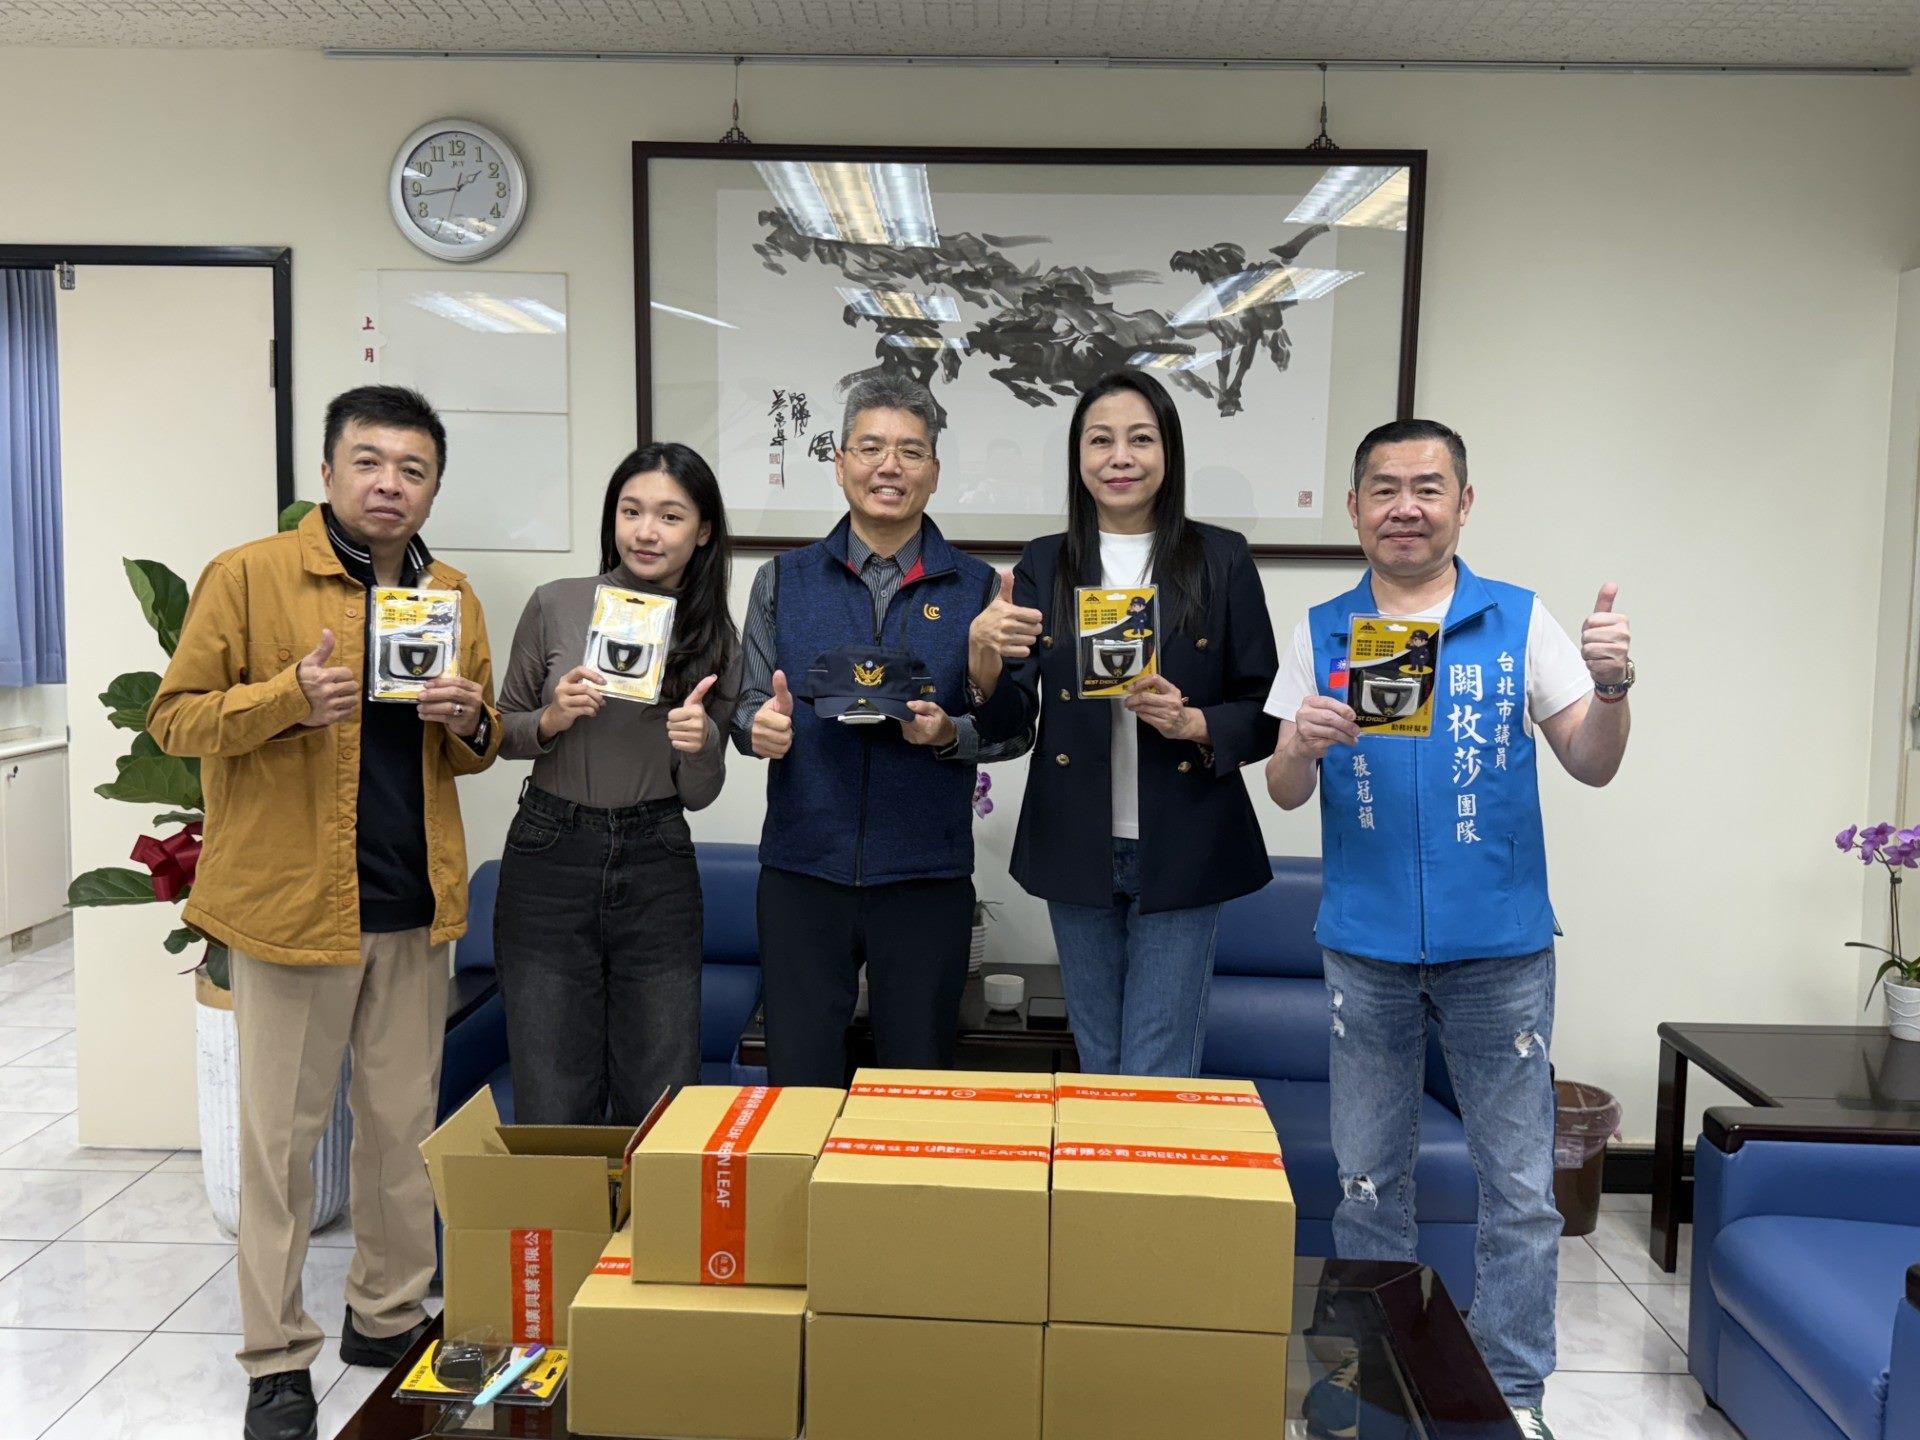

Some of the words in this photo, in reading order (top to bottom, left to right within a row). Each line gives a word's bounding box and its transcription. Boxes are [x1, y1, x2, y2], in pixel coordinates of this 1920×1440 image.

[429, 146, 445, 162] 11
[448, 140, 466, 156] 12
[475, 147, 483, 162] 1
[416, 162, 433, 178] 10
[488, 162, 499, 179] 2
[418, 202, 429, 218] 8
[490, 202, 502, 218] 4
[1494, 651, 1516, 771] 台北市議員
[1447, 664, 1487, 844] 闕枚莎團隊
[925, 1145, 976, 1155] GREEN
[1135, 1151, 1187, 1160] GREEN
[716, 1171, 731, 1209] LEAF
